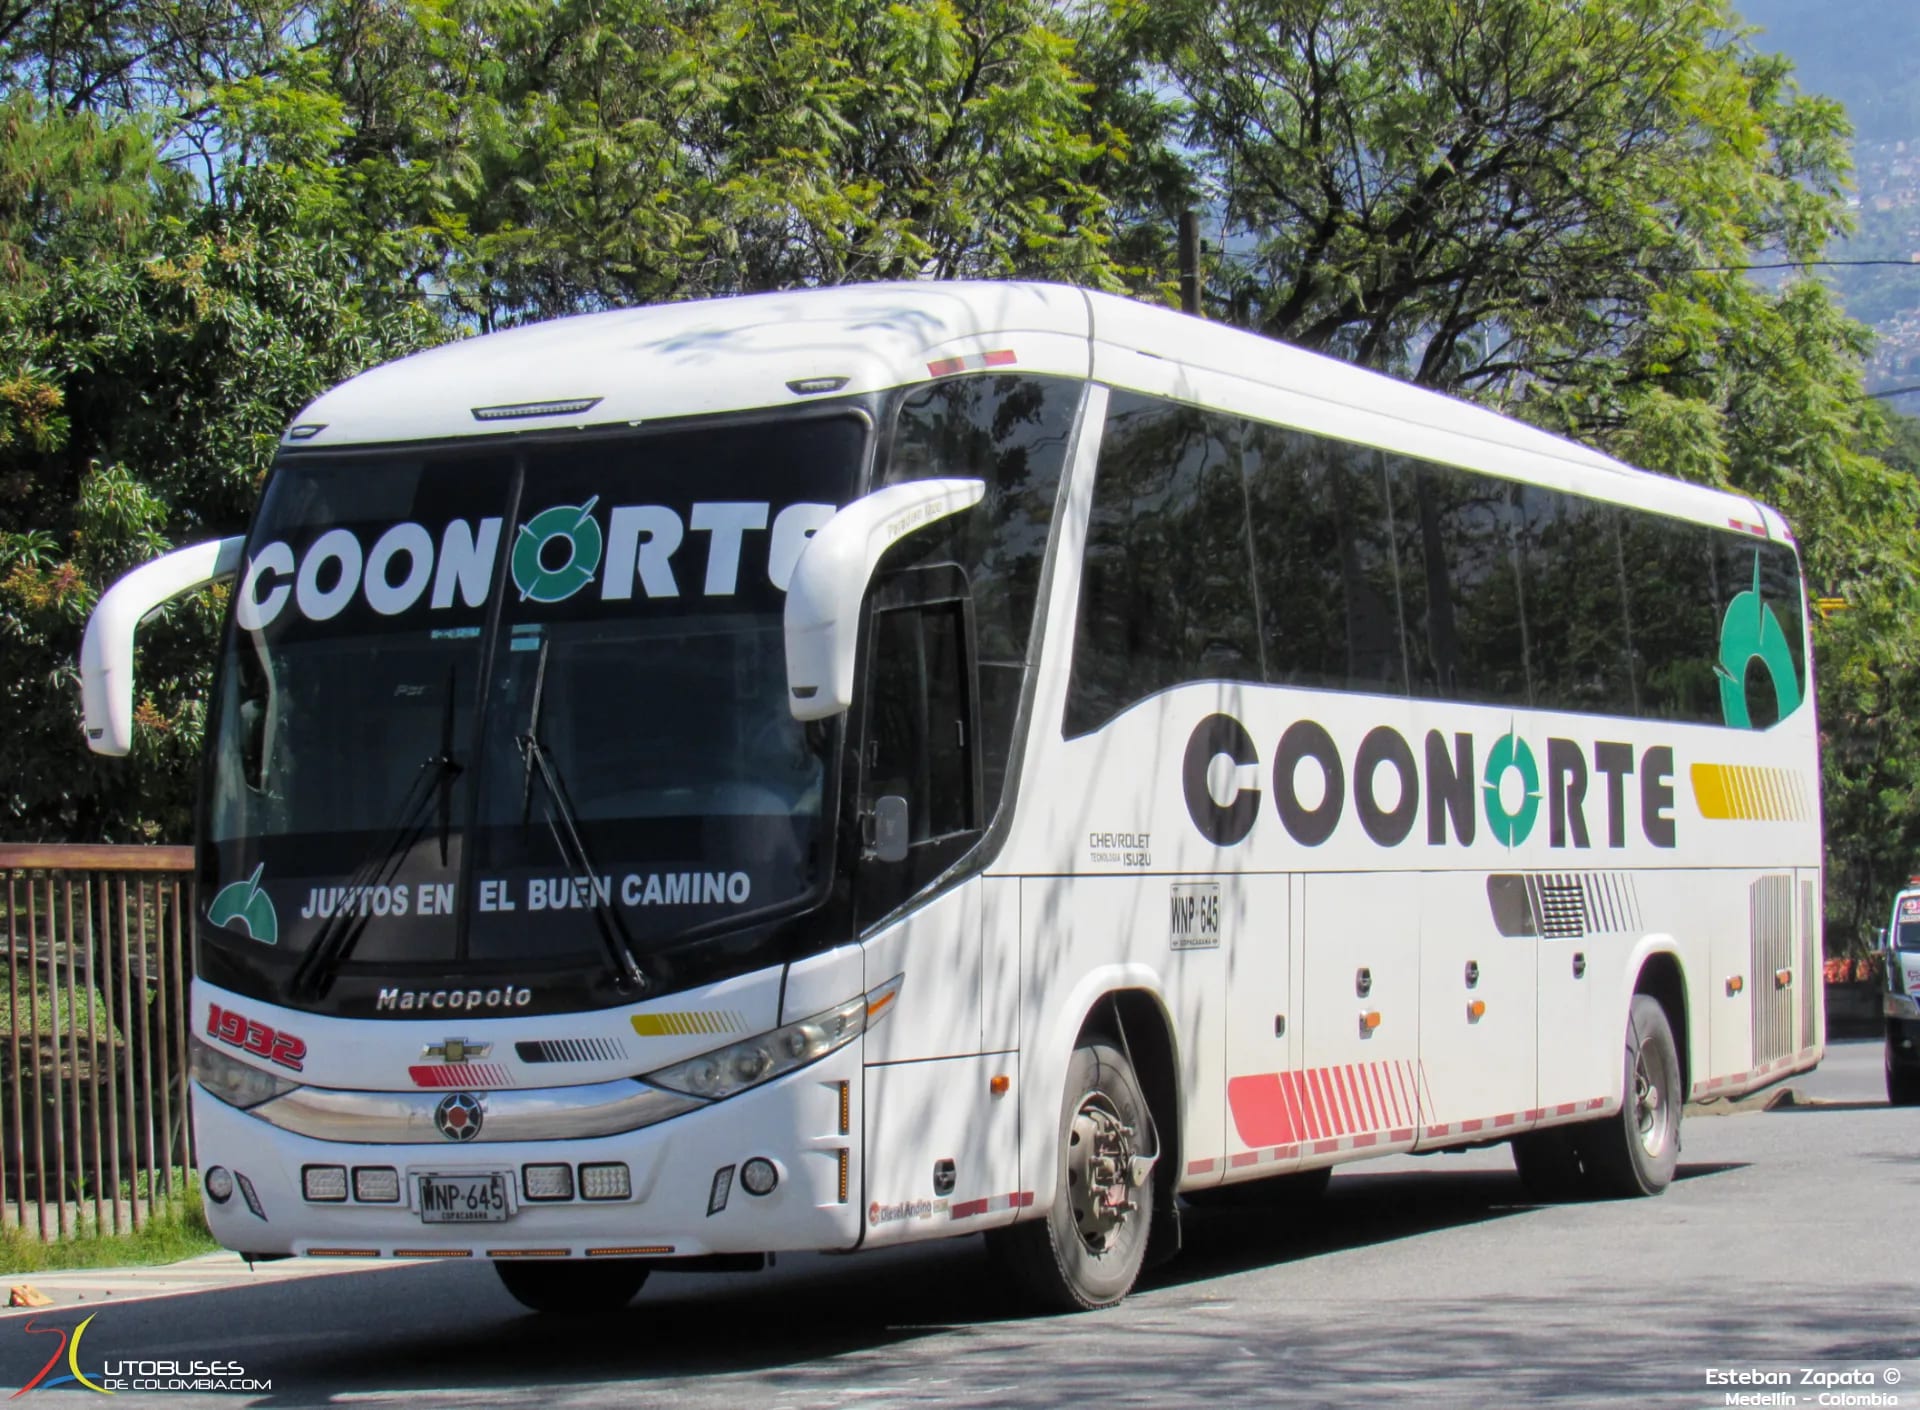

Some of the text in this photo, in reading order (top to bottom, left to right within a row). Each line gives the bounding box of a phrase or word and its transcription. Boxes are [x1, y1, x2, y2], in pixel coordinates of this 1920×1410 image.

[1183, 712, 1676, 852] COONORTE
[1090, 833, 1151, 848] CHEVROLET
[1123, 853, 1152, 867] ISUZU
[301, 871, 751, 919] JUNTOS EN EL BUEN CAMINO
[376, 985, 532, 1012] Marcopolo
[206, 1002, 307, 1073] 1932
